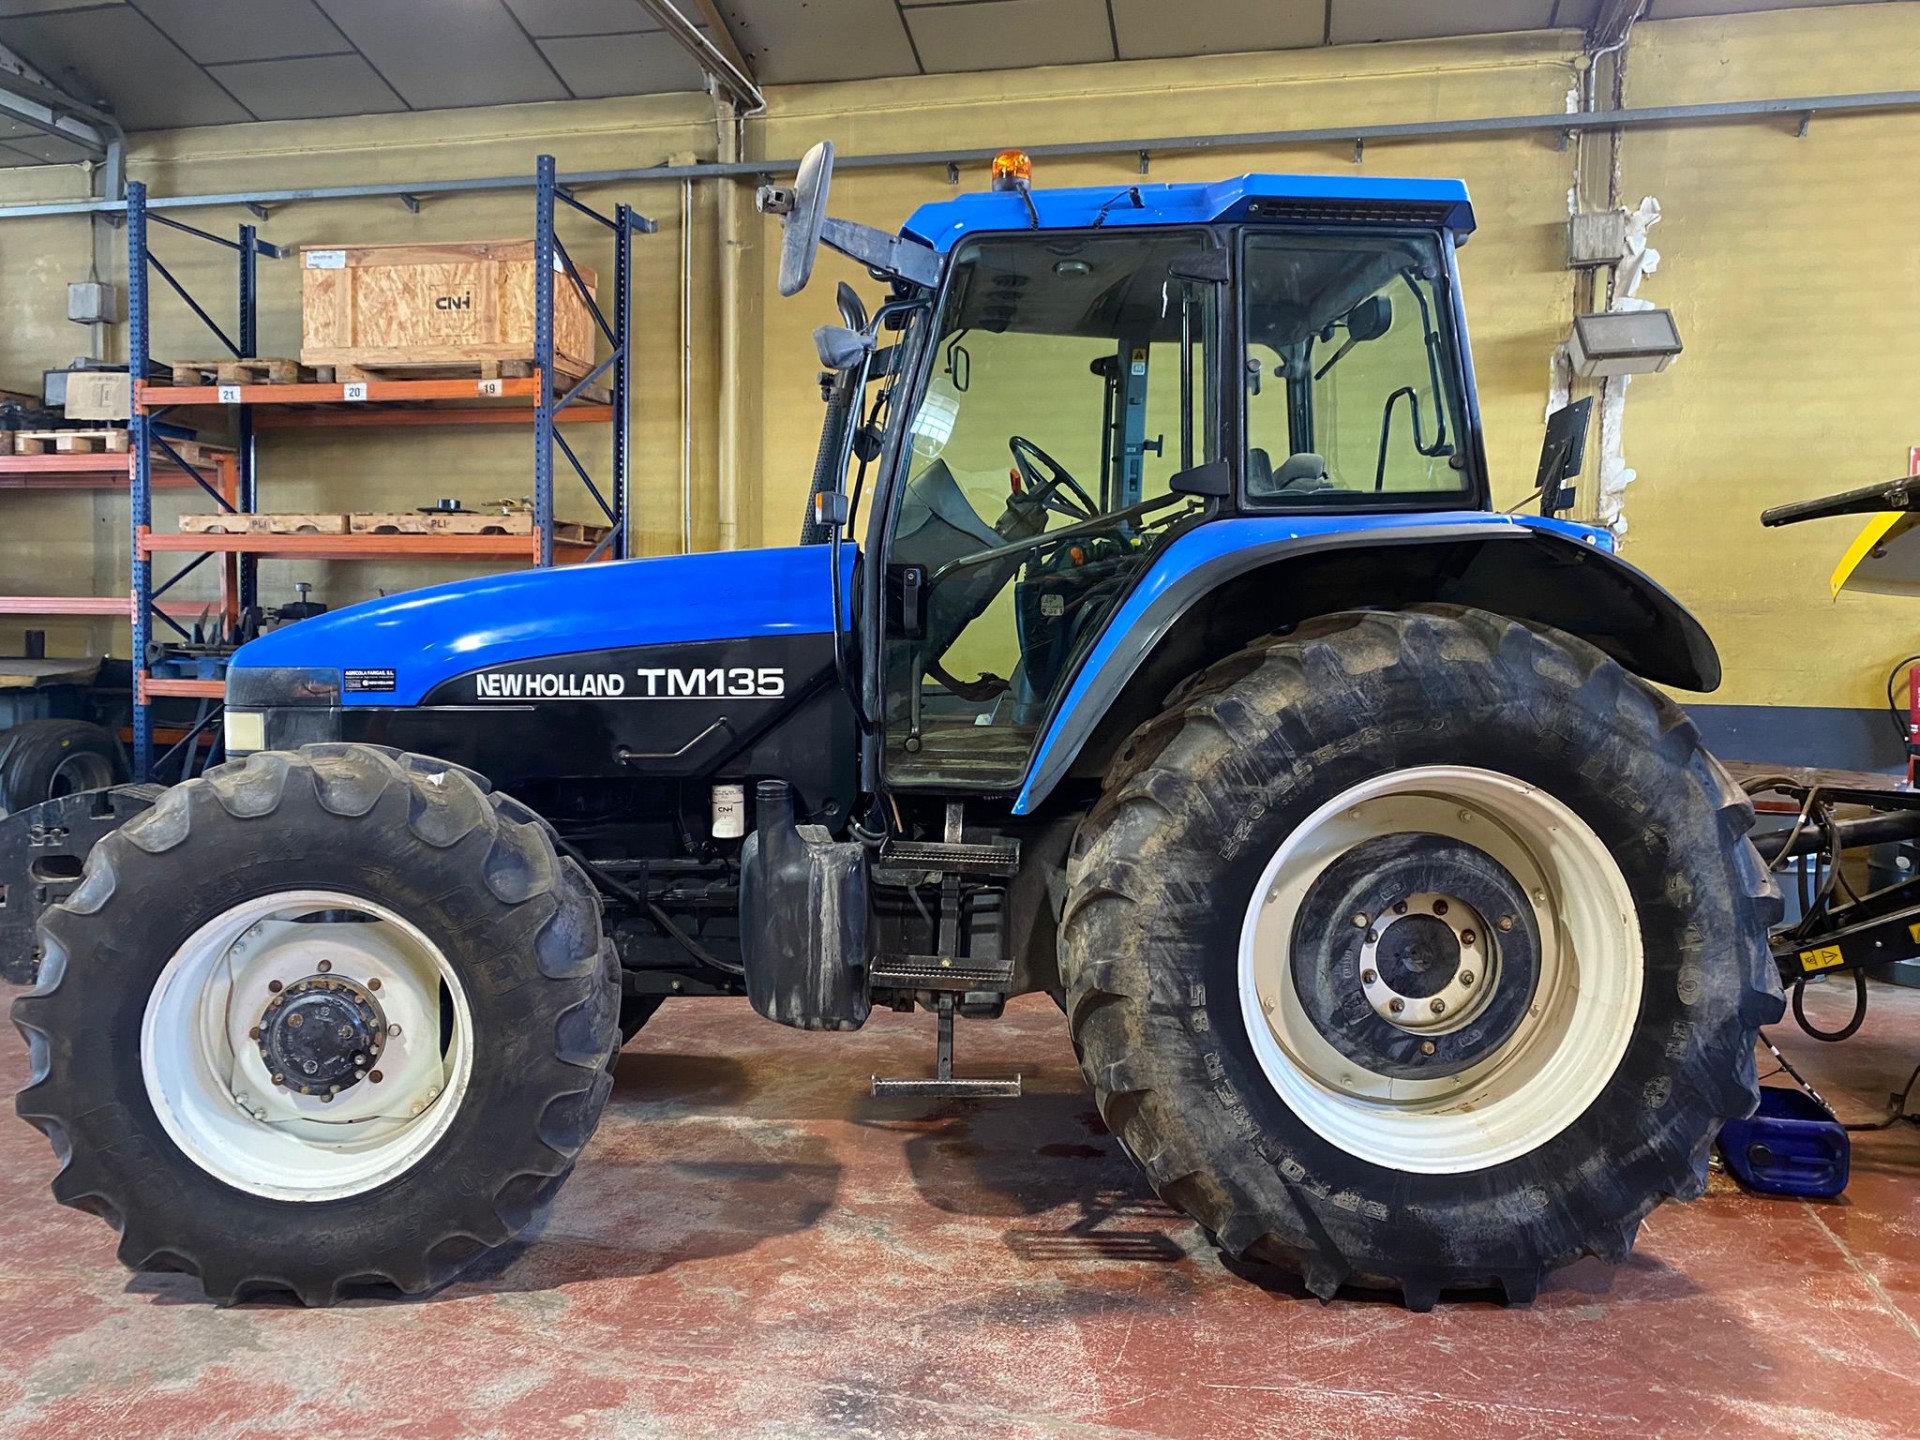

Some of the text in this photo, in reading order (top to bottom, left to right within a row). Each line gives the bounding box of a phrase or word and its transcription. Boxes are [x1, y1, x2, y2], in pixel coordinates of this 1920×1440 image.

[349, 387, 361, 398] 20
[484, 383, 496, 394] 19
[223, 390, 234, 400] 21
[476, 668, 785, 697] NEW HOLLAND TM135
[1203, 1051, 1390, 1223] ERFORMER
